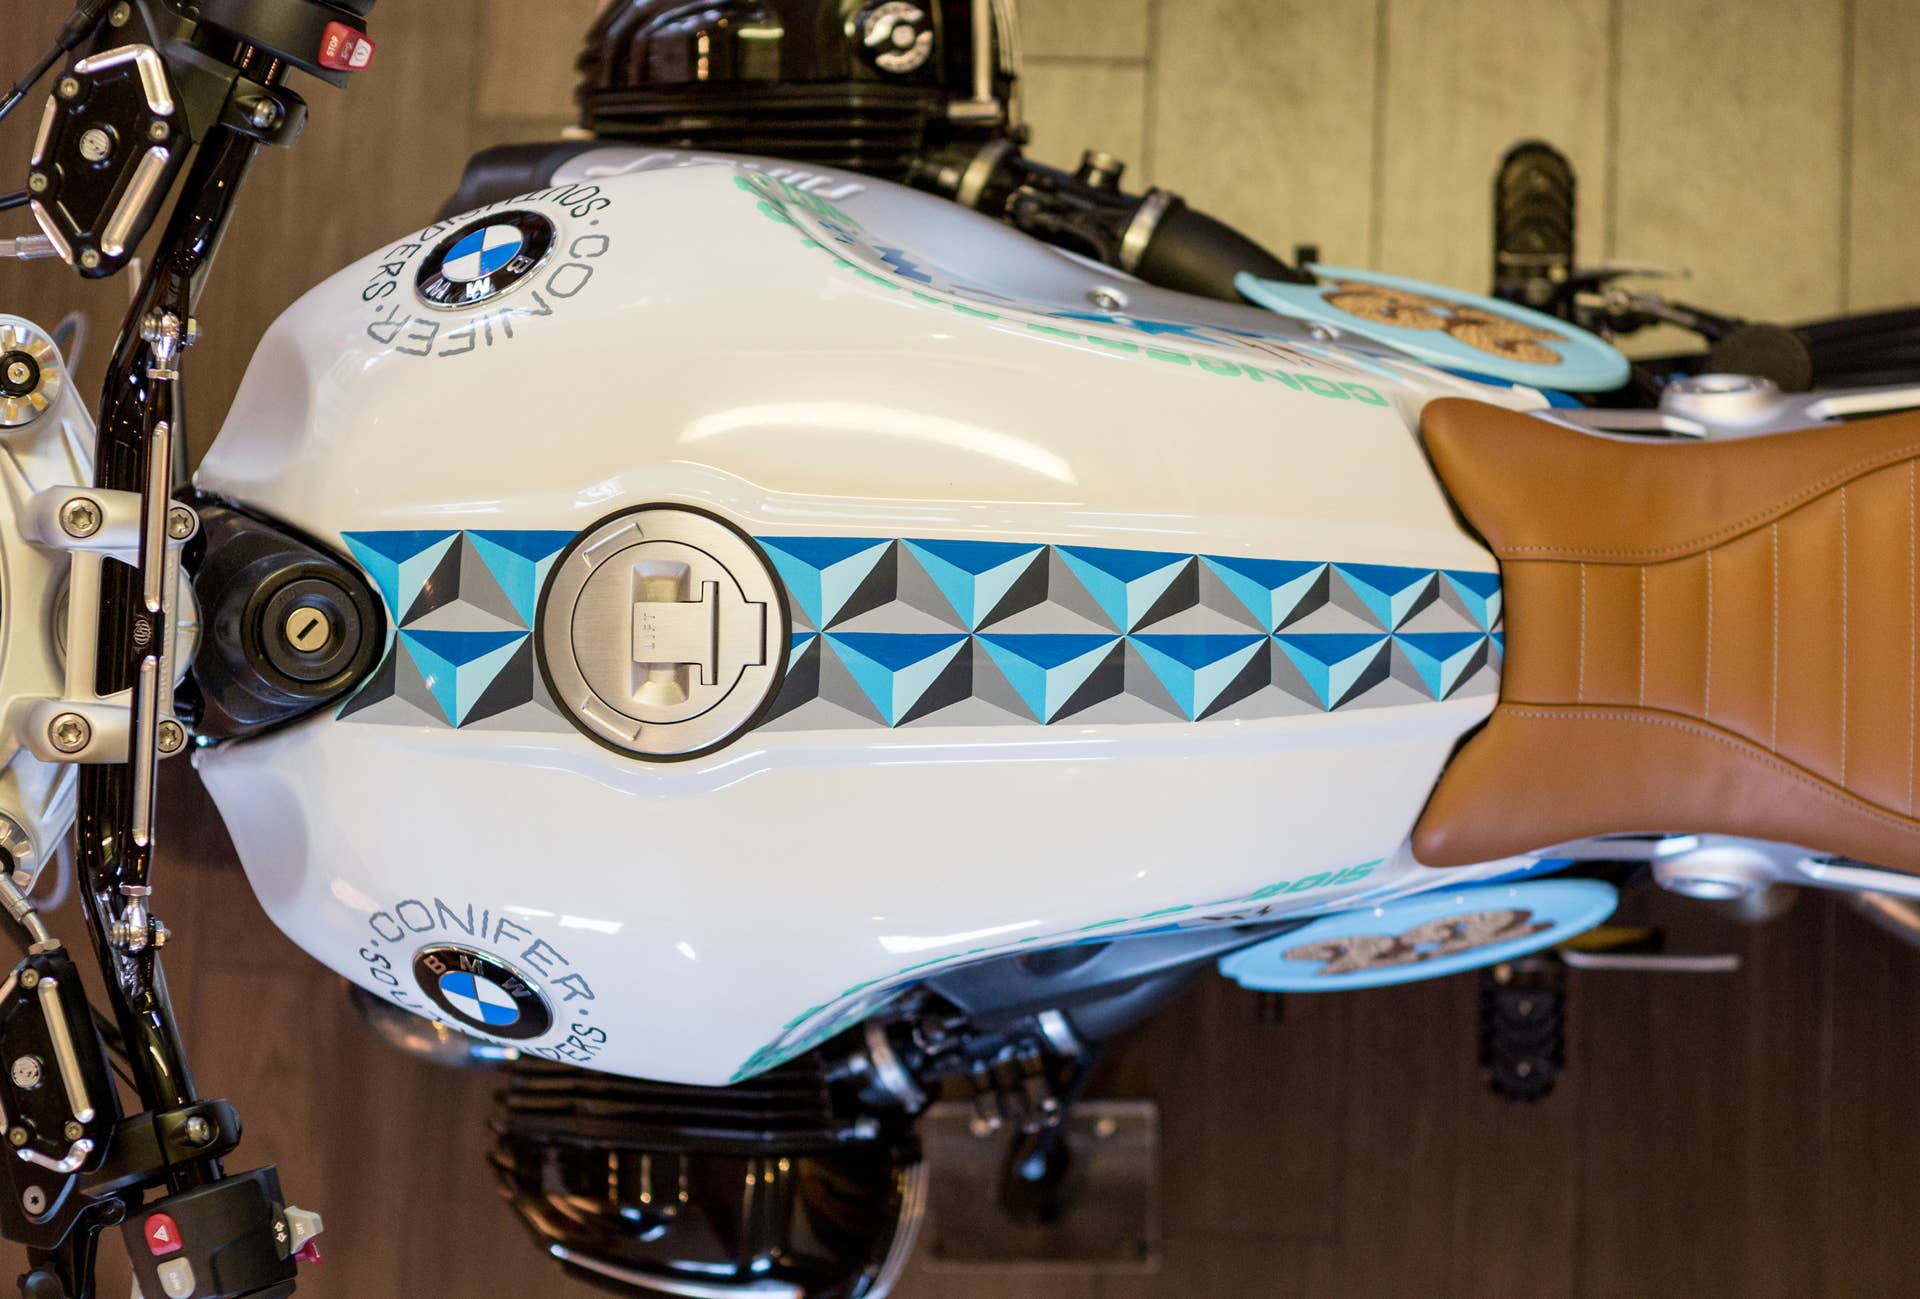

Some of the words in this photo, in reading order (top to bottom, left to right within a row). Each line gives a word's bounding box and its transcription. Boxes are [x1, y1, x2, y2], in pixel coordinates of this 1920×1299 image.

[326, 35, 339, 57] STOP
[367, 234, 610, 357] CONIFER
[424, 254, 535, 300] BMW
[369, 897, 595, 1001] CONIFER
[423, 954, 532, 998] BMW
